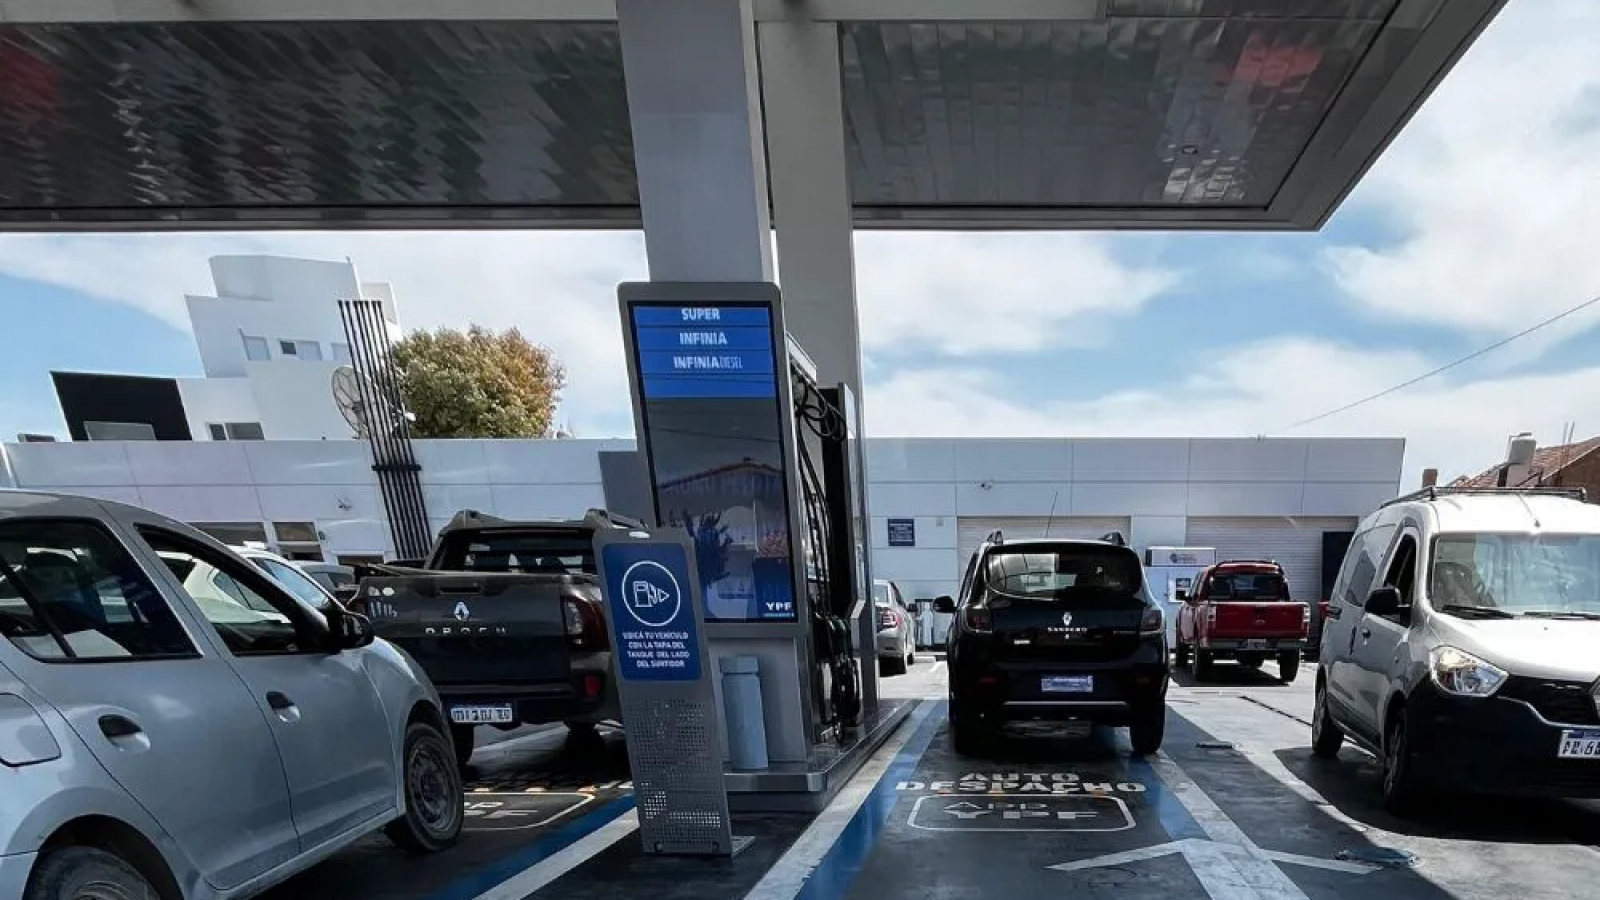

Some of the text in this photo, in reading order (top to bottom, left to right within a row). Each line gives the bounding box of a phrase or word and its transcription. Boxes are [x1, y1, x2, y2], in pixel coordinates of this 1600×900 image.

[681, 308, 720, 320] SUPER
[680, 332, 728, 345] INFINIA
[673, 356, 719, 369] INFINIA
[765, 601, 792, 611] YPF
[628, 641, 643, 649] CON
[643, 641, 653, 649] LA
[671, 641, 686, 649] DEL
[655, 651, 670, 659] DEL
[636, 659, 650, 668] DEL
[960, 772, 1079, 782] AUTO
[895, 780, 1147, 794] DESPACHO
[943, 810, 1099, 819] YPF
